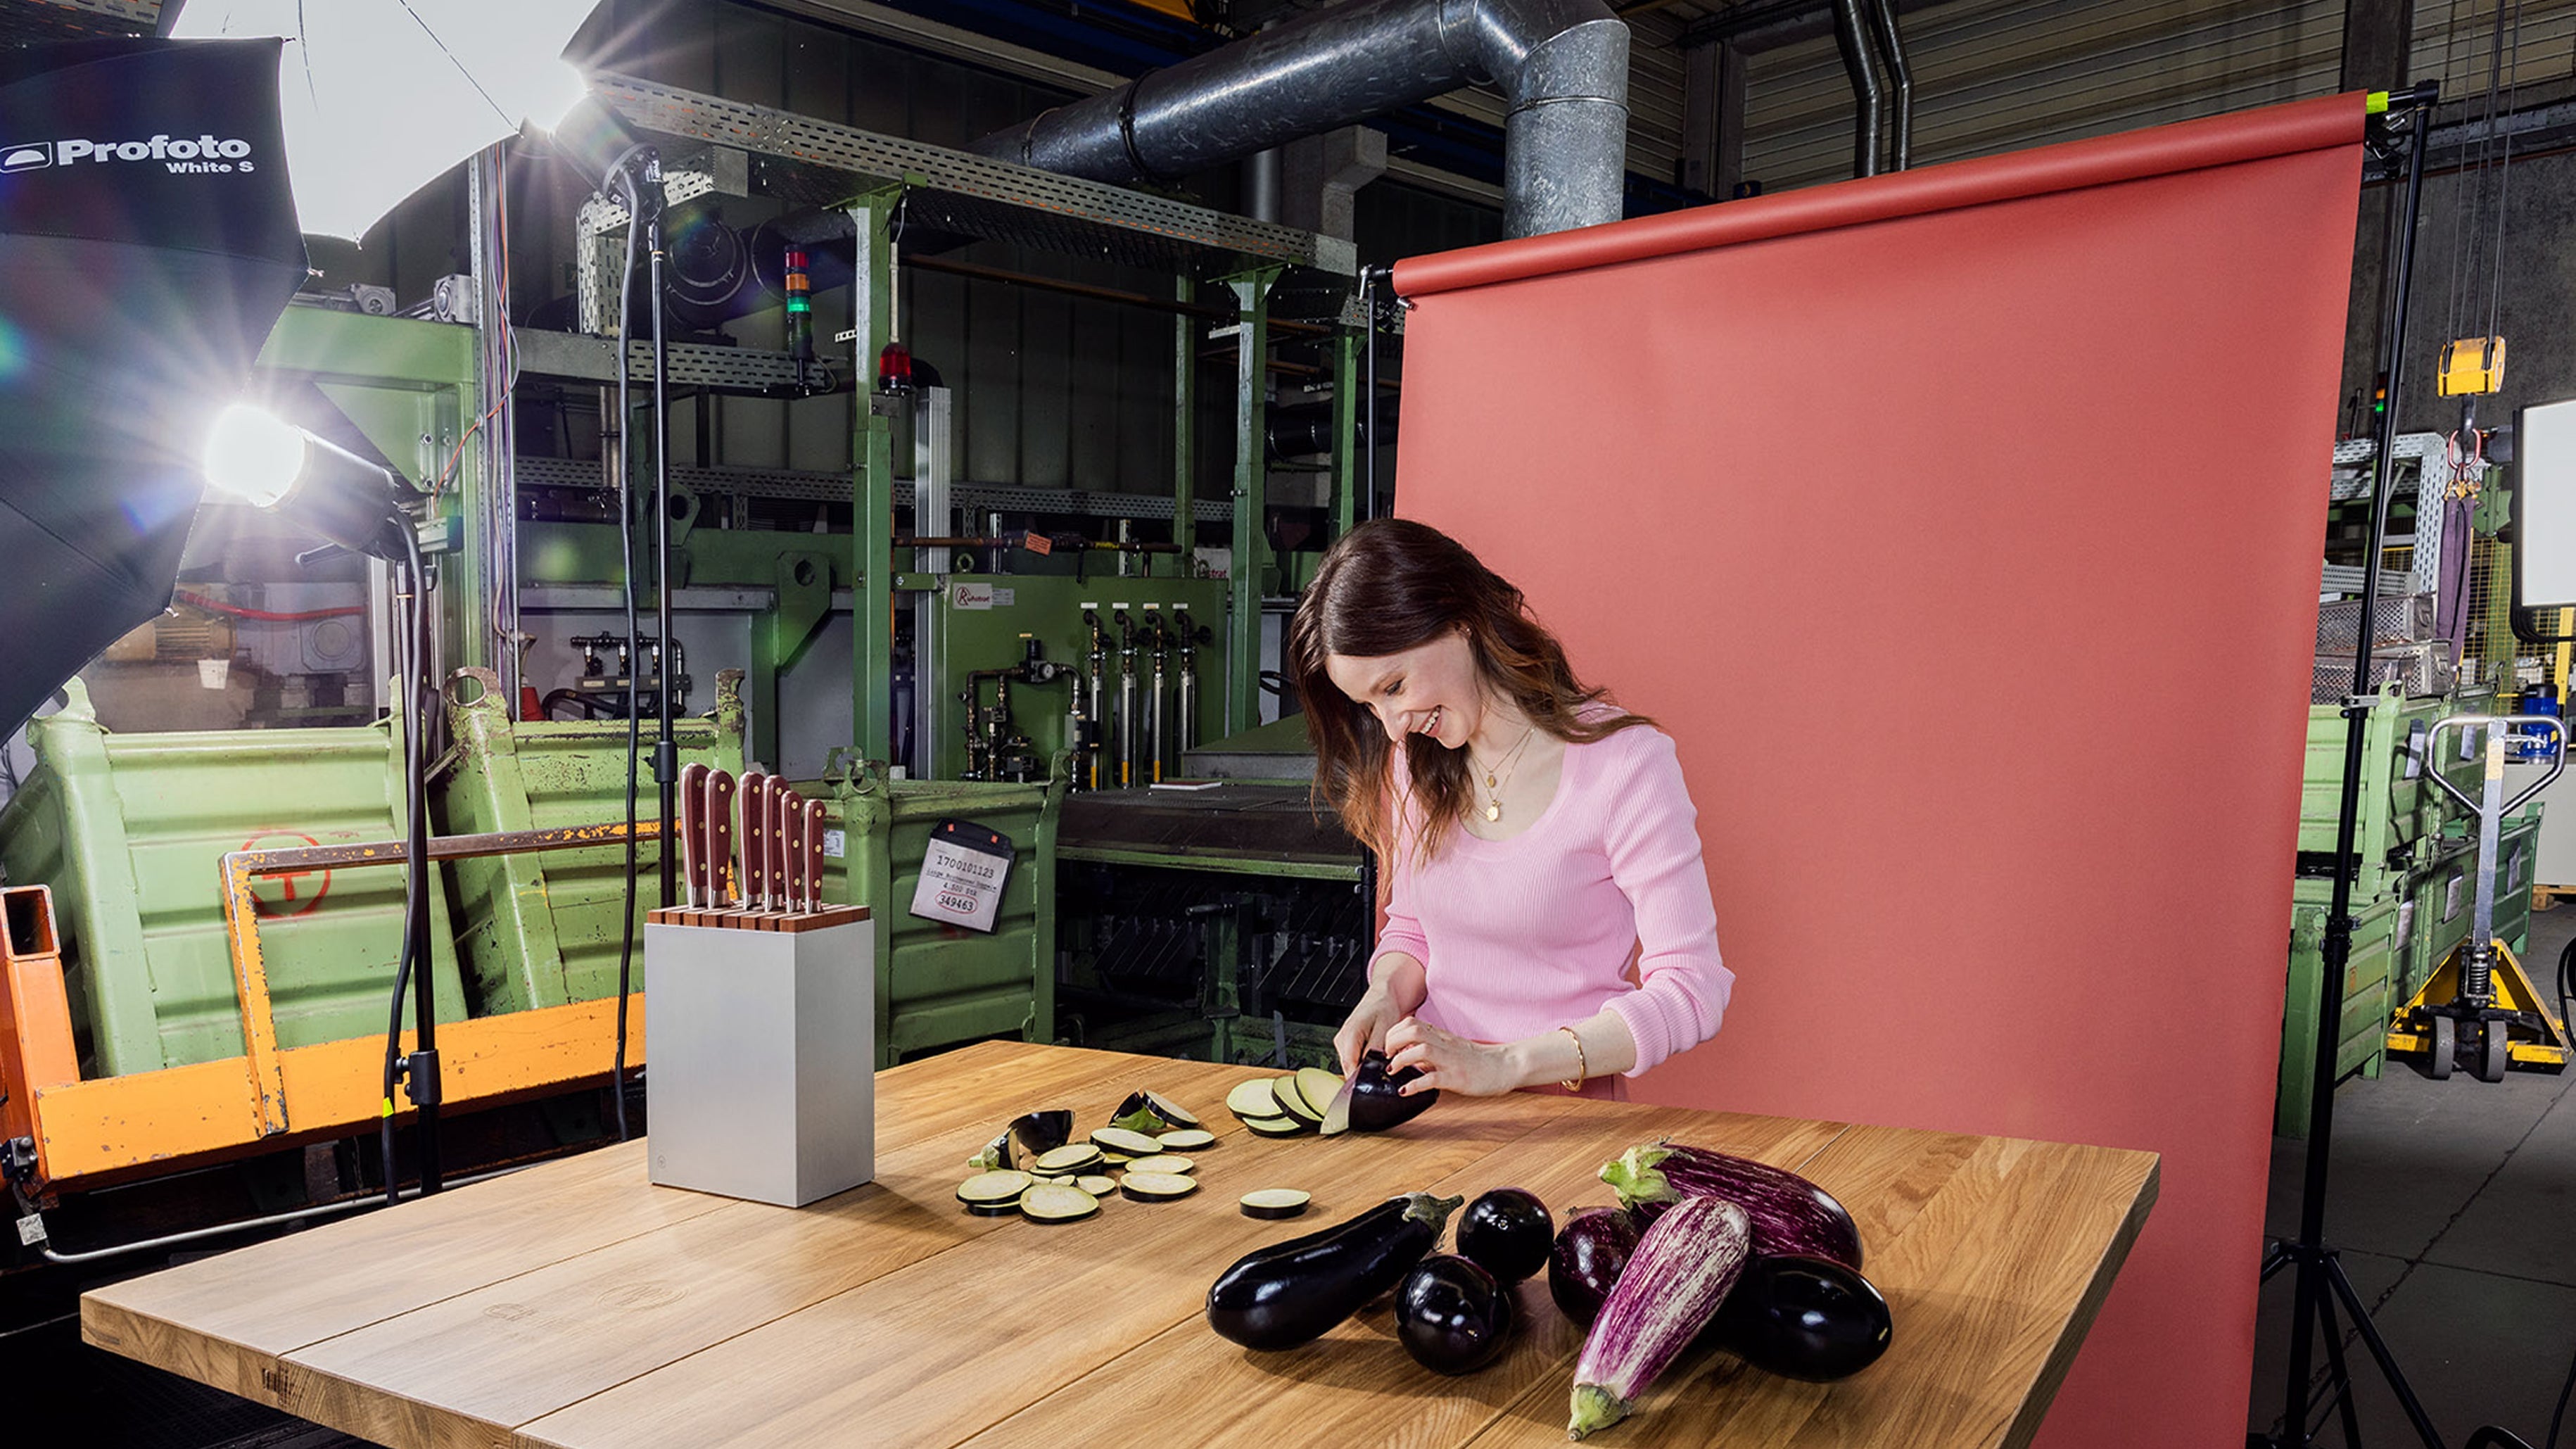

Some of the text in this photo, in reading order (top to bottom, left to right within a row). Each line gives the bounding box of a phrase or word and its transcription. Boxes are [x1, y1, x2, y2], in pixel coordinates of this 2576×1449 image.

[57, 134, 251, 165] Profoto
[165, 160, 255, 174] White S
[937, 854, 994, 879] 1700101123
[939, 894, 974, 911] 349463
